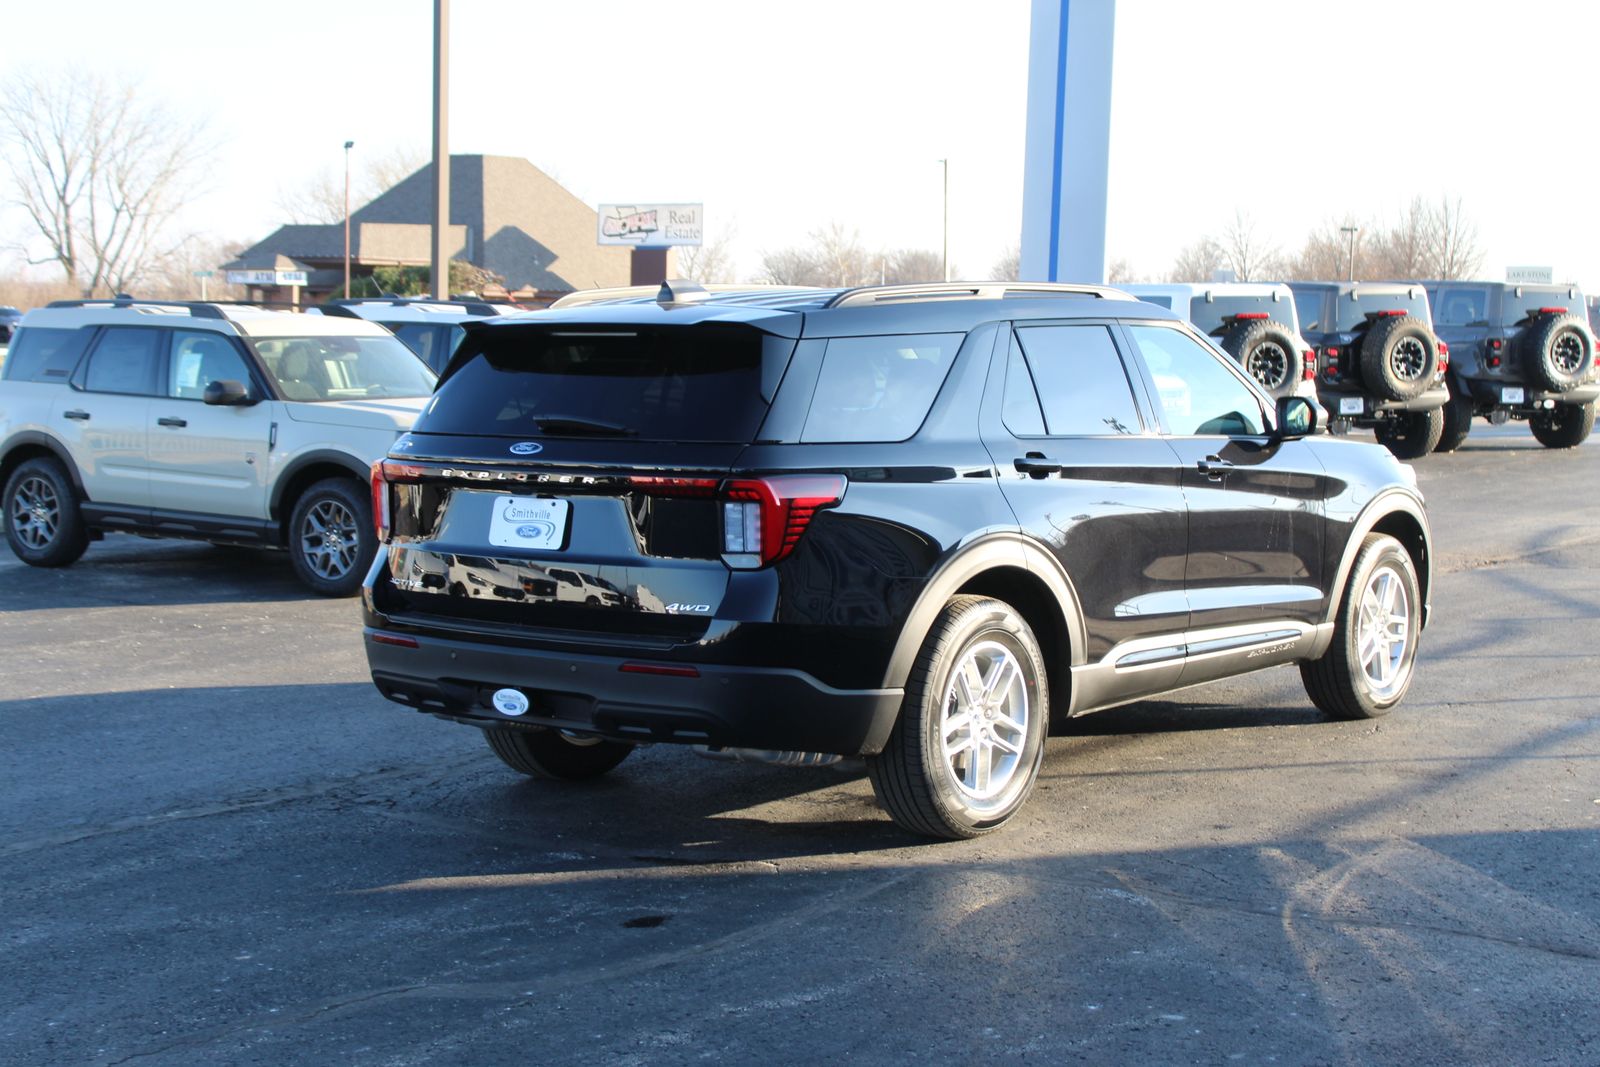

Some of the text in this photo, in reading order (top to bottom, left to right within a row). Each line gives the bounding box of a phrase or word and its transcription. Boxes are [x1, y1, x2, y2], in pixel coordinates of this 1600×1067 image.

[669, 210, 696, 224] Real
[665, 225, 701, 239] Estate
[441, 469, 596, 485] EXPLORER
[511, 508, 551, 520] Smithville
[665, 603, 710, 612] 4WD
